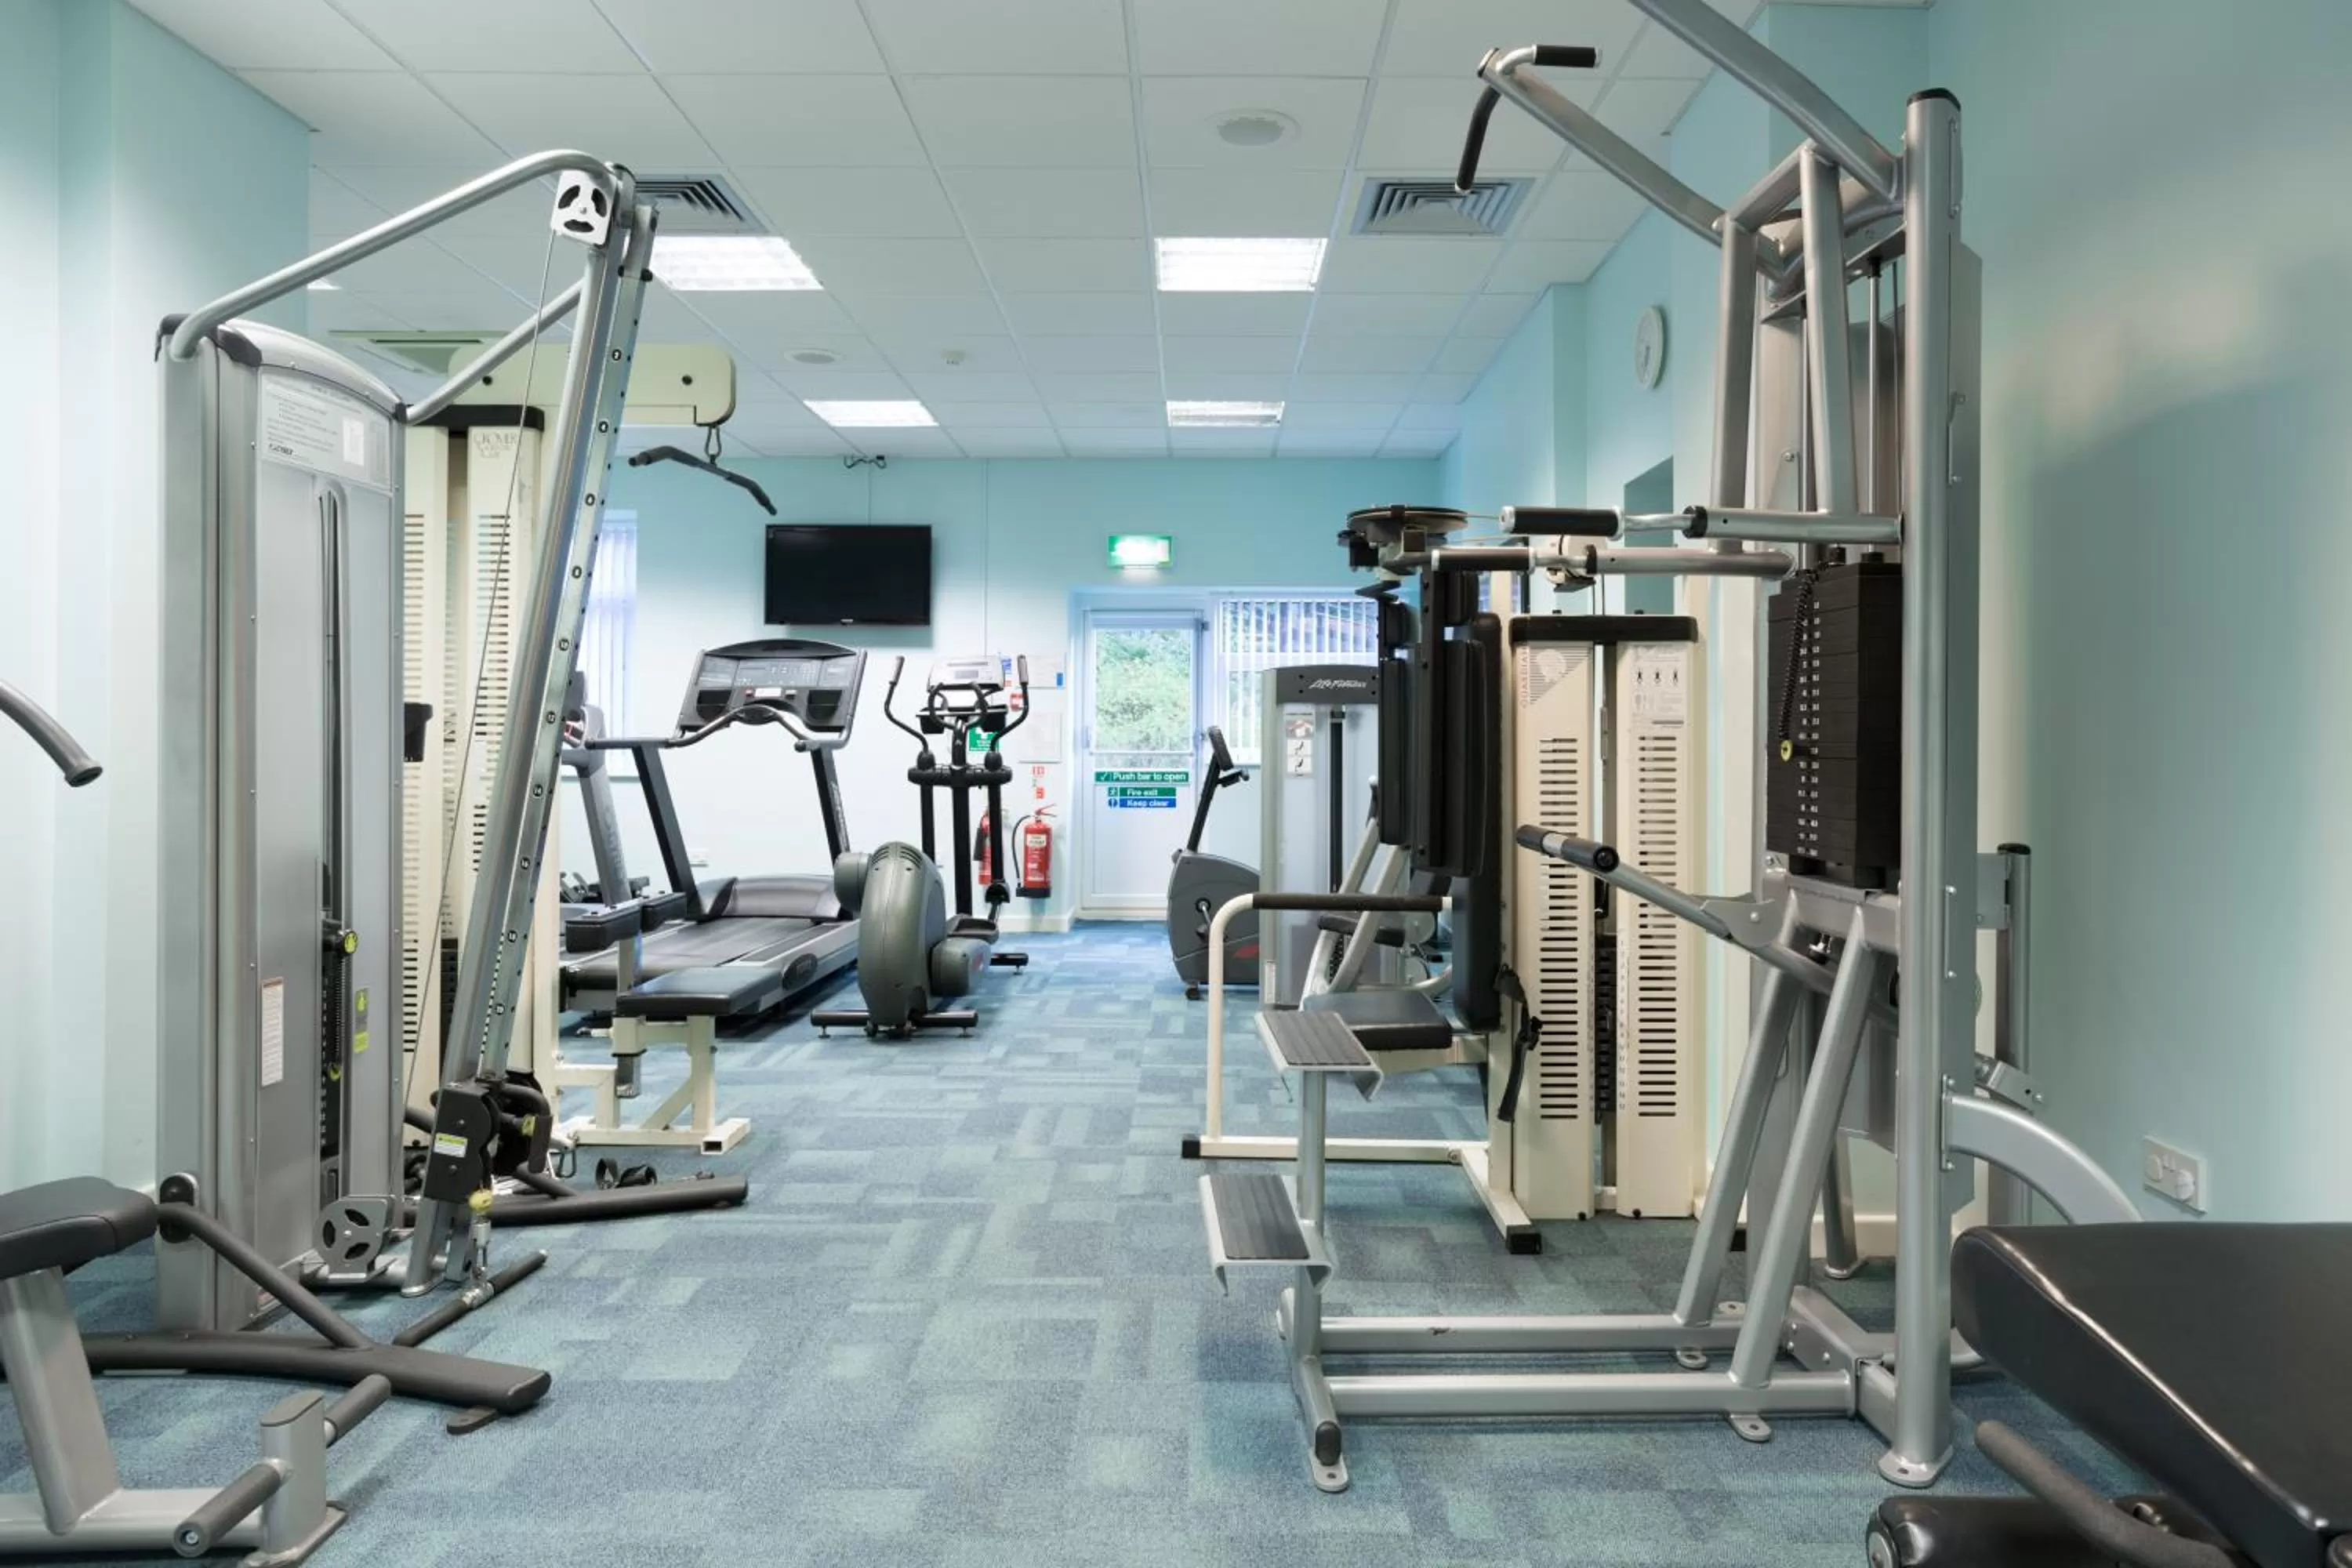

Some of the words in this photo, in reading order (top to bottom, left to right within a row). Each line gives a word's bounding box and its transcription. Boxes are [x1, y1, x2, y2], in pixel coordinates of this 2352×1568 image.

[1113, 771, 1136, 780] Push
[1138, 771, 1151, 780] bar
[1163, 773, 1186, 782] open
